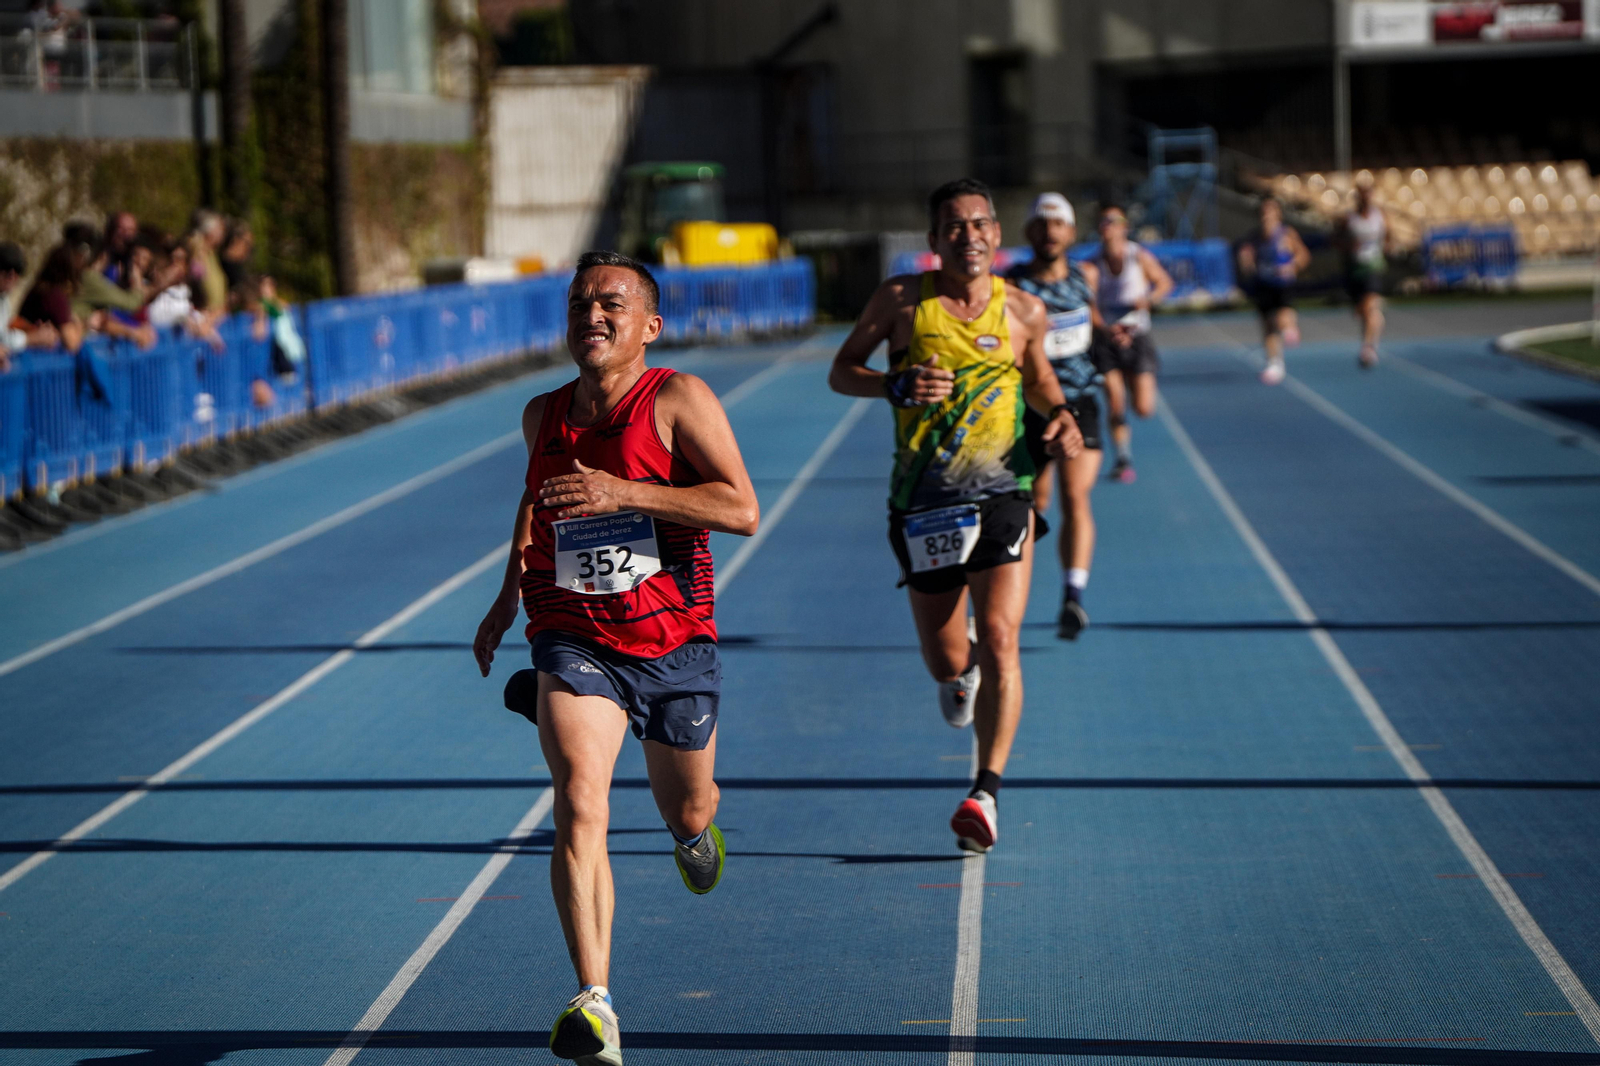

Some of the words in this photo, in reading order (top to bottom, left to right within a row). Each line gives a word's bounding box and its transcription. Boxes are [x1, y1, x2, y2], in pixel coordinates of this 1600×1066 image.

[579, 520, 608, 530] Carrera
[609, 515, 634, 526] Popul
[572, 531, 598, 541] Ciudad
[598, 529, 609, 538] de
[611, 526, 632, 536] Jerez
[925, 530, 964, 556] 826
[576, 545, 635, 579] 352
